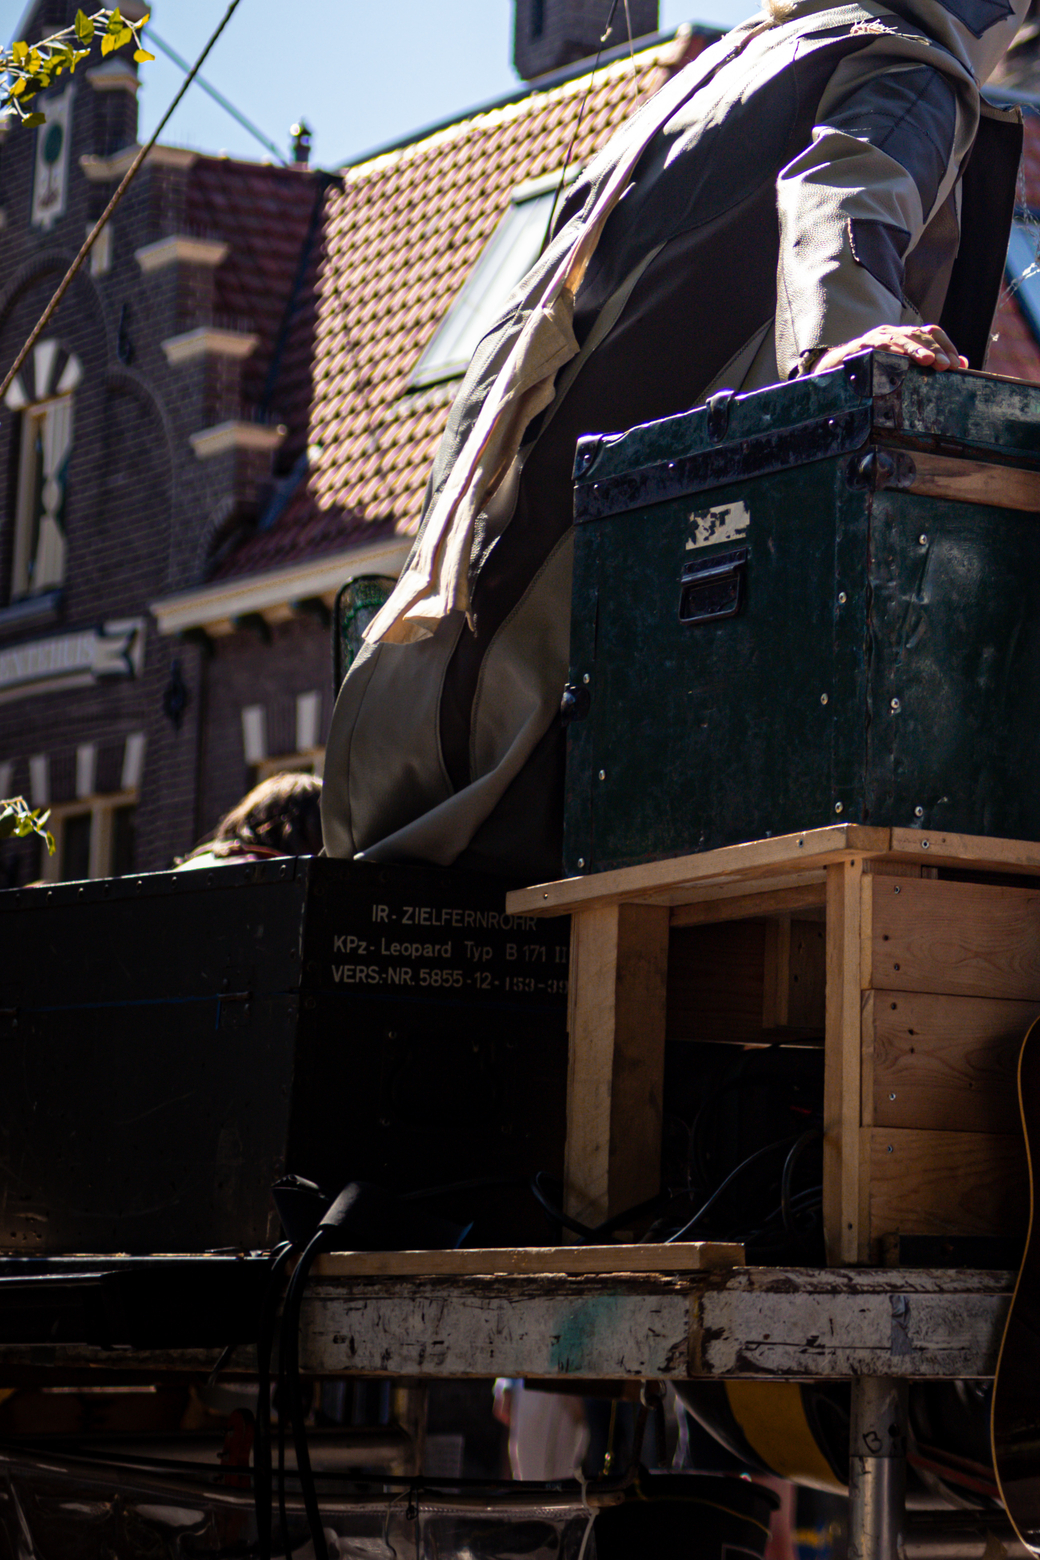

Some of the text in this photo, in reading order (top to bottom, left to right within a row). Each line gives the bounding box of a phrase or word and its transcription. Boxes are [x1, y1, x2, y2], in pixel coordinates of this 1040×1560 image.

[464, 941, 493, 963] Typ
[505, 943, 518, 961] B
[522, 944, 546, 963] 171
